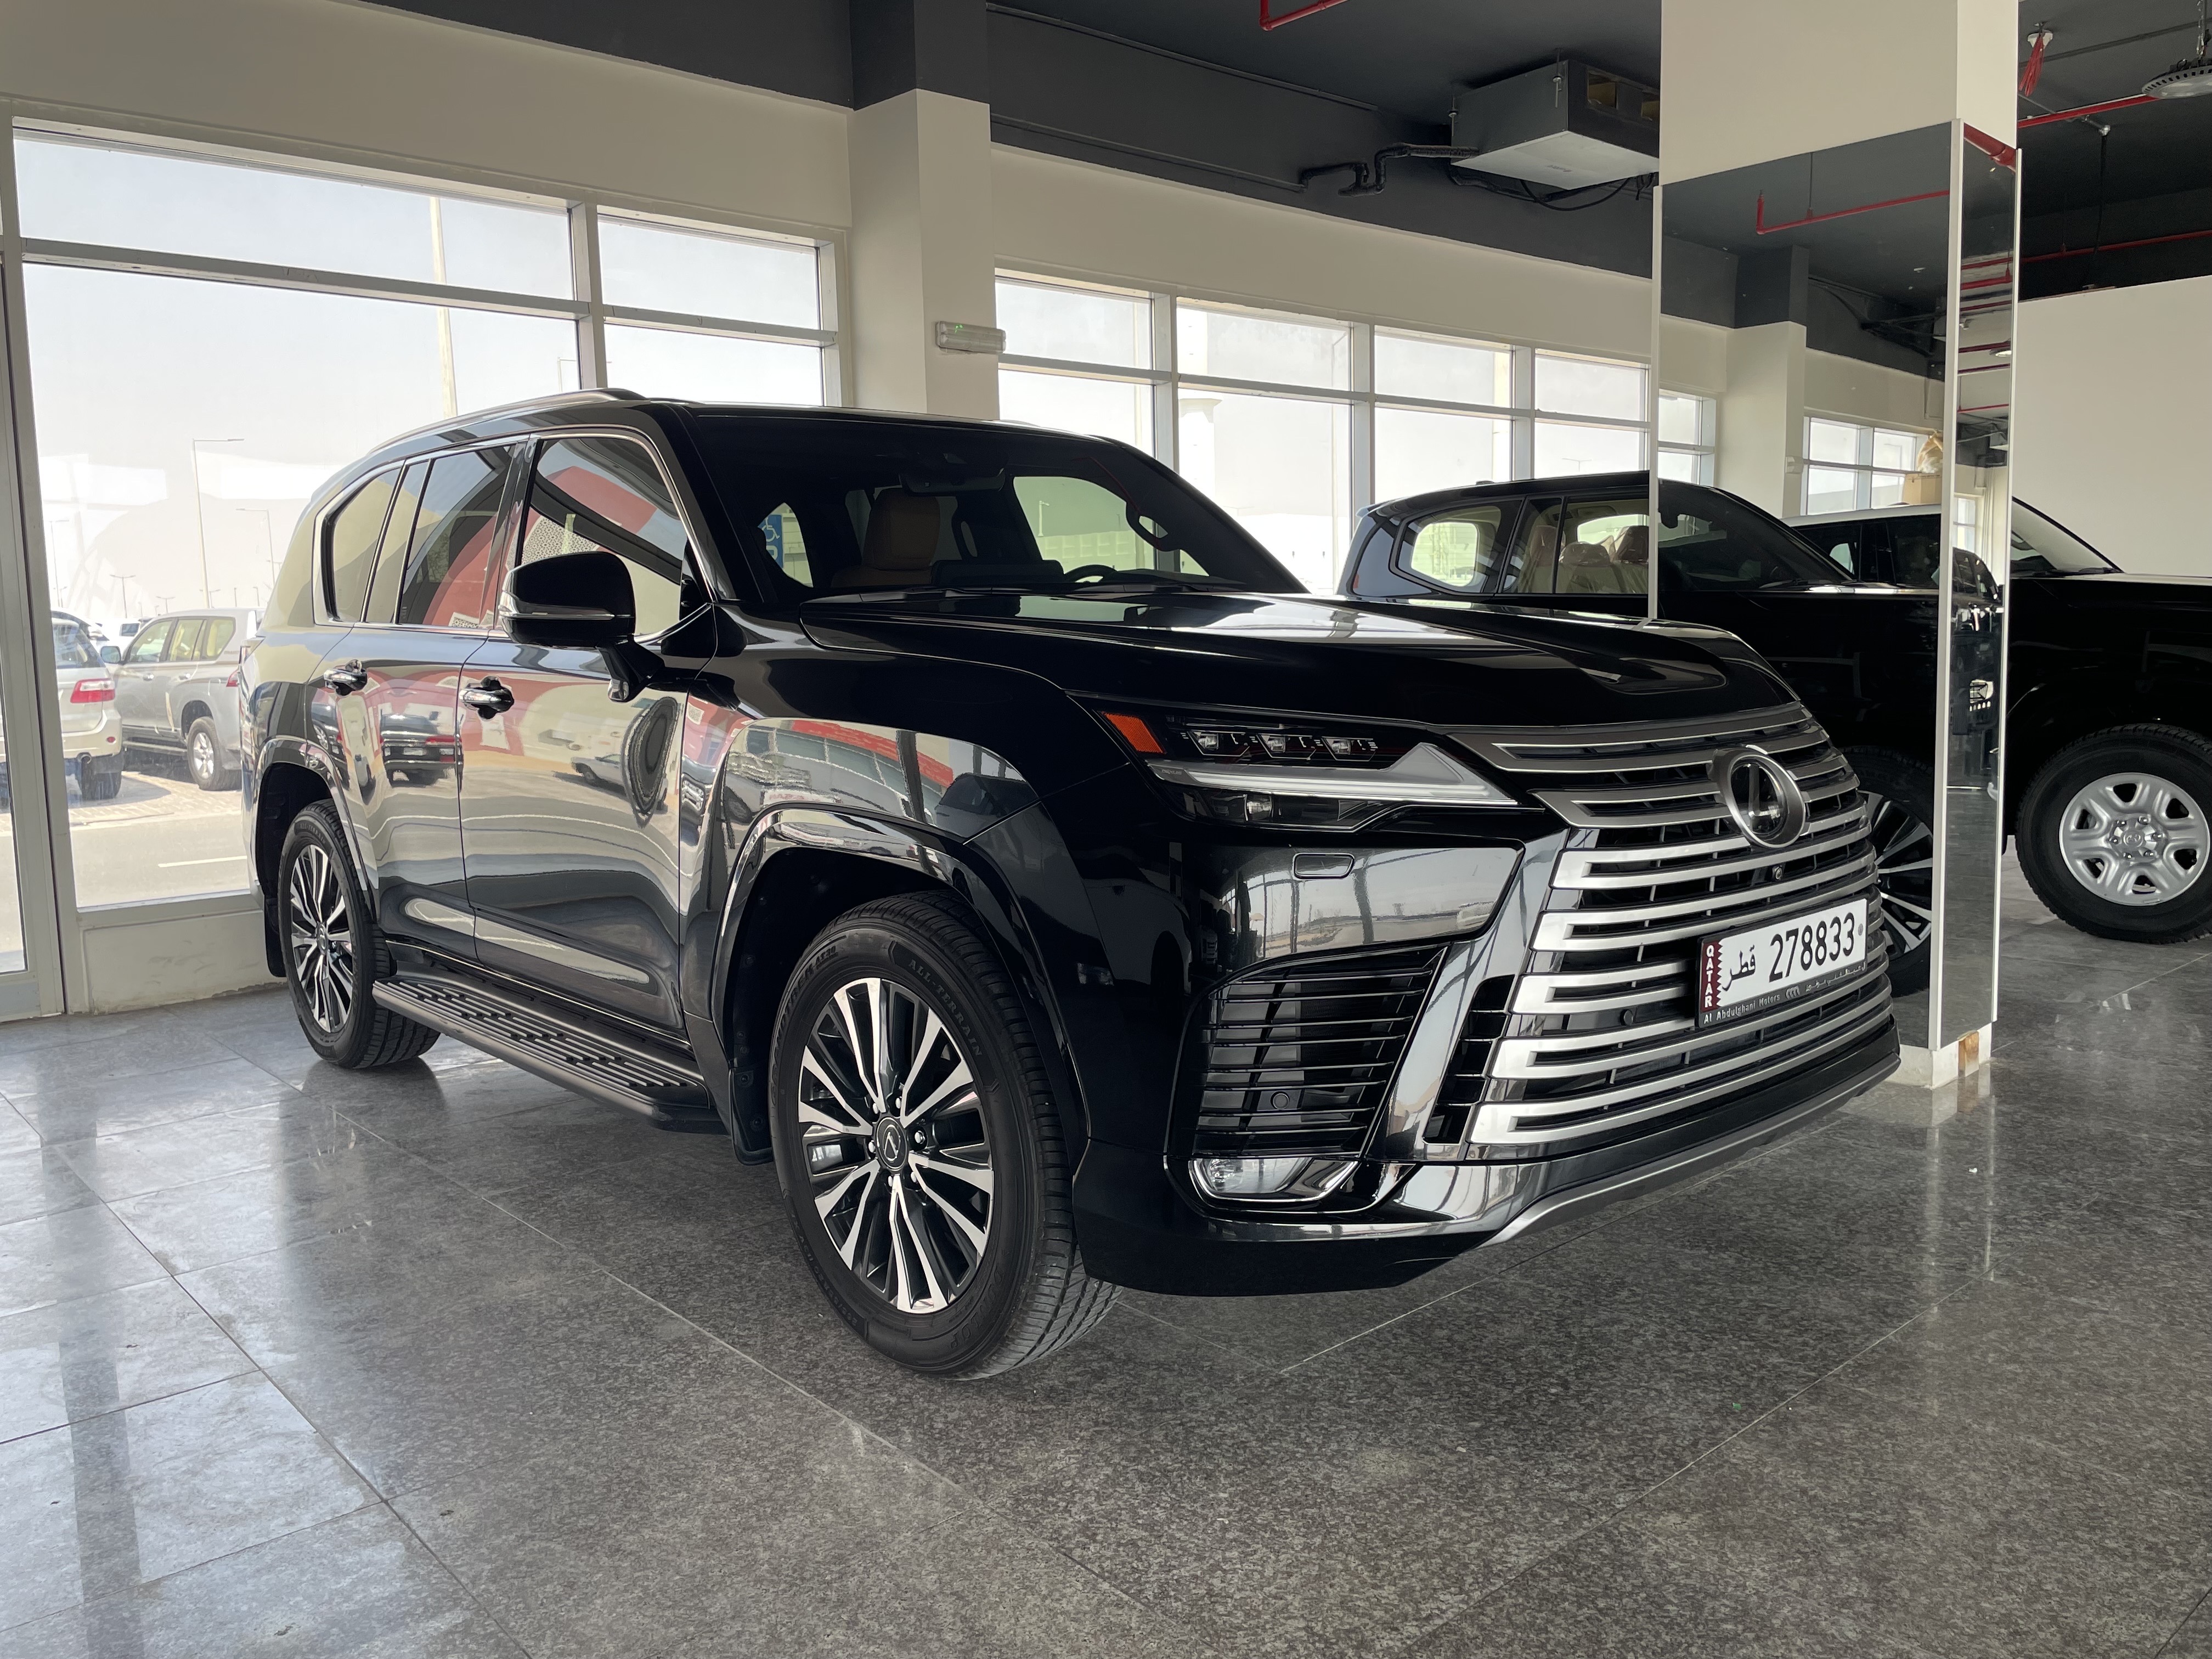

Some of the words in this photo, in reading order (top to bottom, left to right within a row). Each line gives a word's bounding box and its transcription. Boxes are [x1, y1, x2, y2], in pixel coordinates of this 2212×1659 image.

[1704, 945, 1714, 1008] QATAR
[1721, 944, 1756, 992] قطر
[1769, 912, 1854, 983] 278833
[907, 958, 983, 1057] ALL-TERRAIN
[1703, 1014, 1712, 1024] Al
[1716, 1000, 1756, 1021] Abdulghani
[1759, 994, 1781, 1007] Motors
